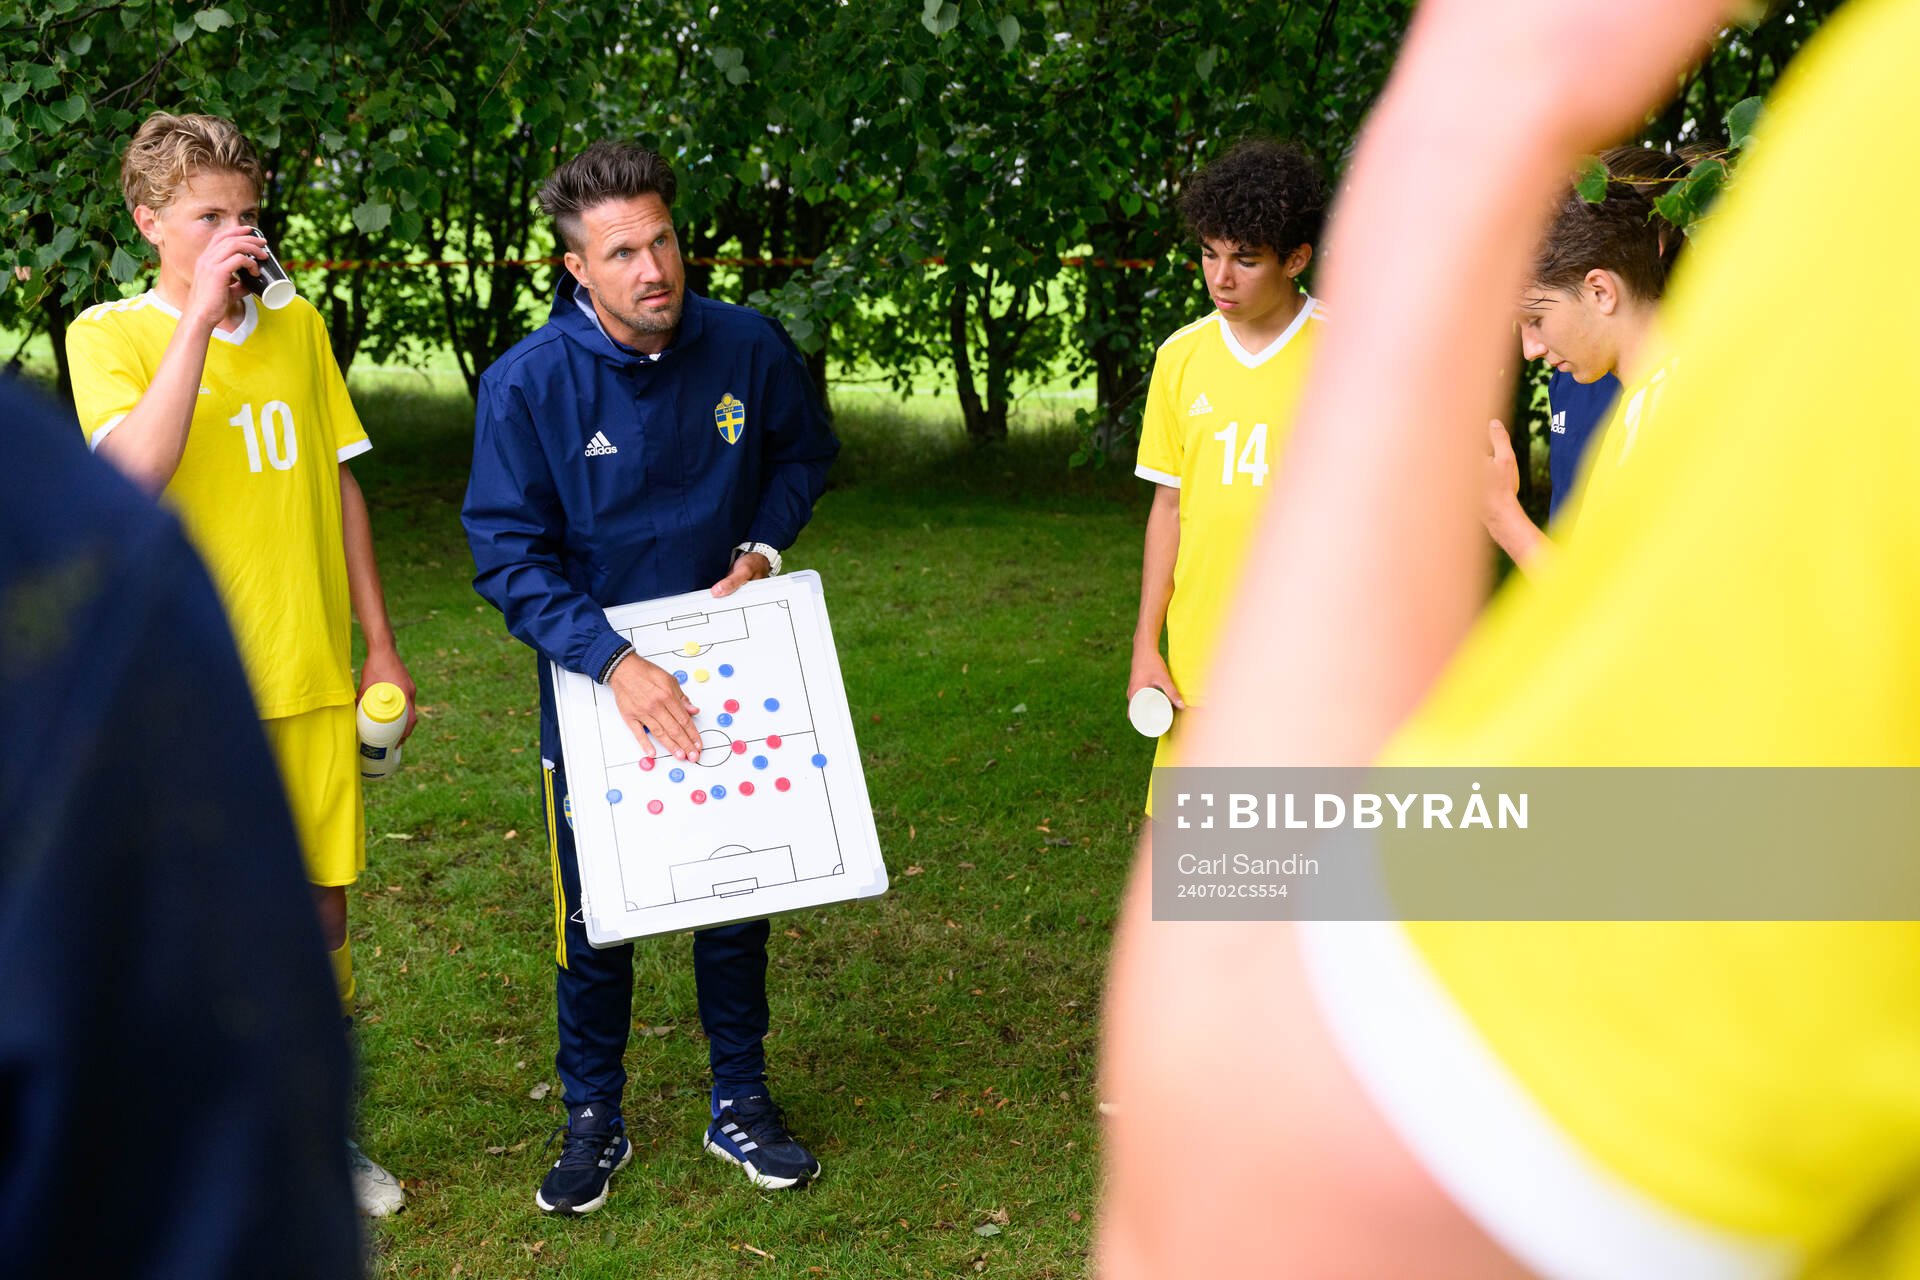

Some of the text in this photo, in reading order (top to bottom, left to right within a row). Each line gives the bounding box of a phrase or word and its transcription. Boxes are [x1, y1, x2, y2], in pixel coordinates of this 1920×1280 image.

[228, 399, 298, 473] 10
[584, 446, 618, 457] adidas
[1213, 421, 1269, 487] 14
